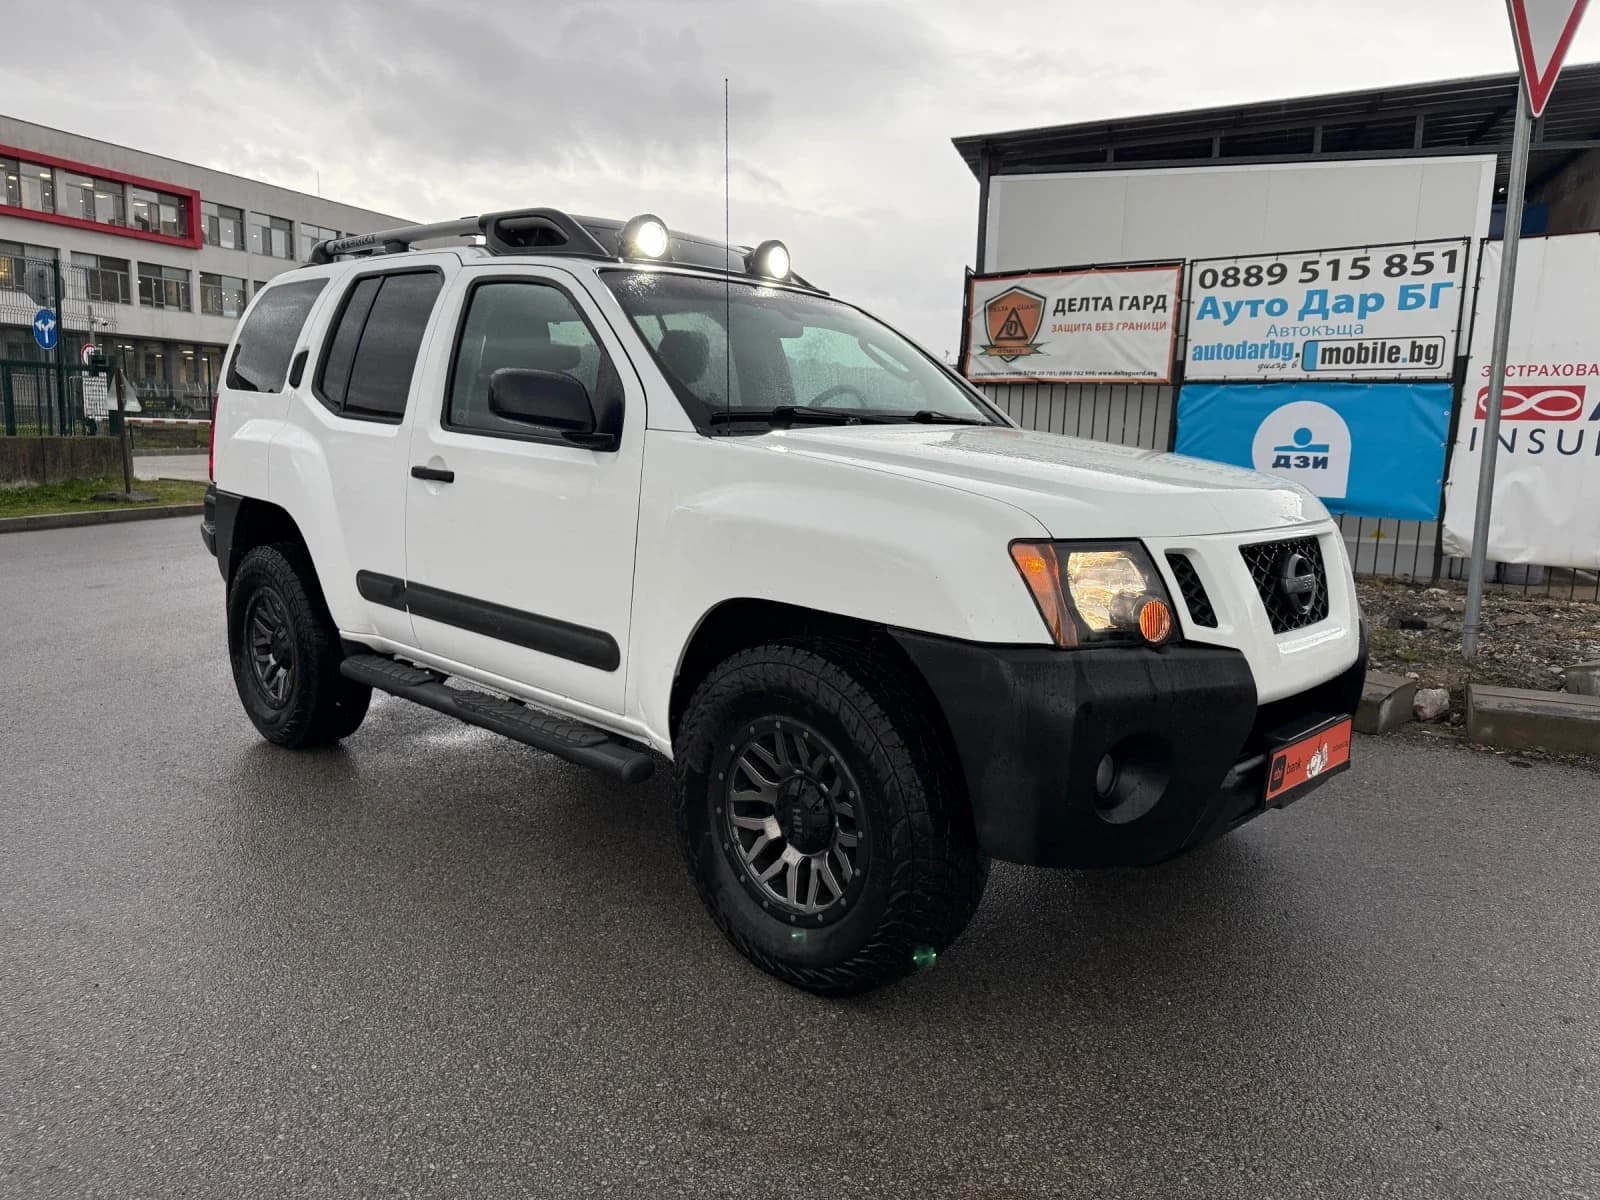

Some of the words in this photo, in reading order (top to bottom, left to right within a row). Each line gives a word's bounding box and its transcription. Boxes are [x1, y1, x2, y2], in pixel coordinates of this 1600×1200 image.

[1198, 262, 1288, 290] 0889
[1297, 256, 1371, 284] 515
[1383, 249, 1458, 278] 851
[1052, 296, 1114, 317] ДЕЛТА
[1118, 294, 1168, 314] ГАРД
[1195, 295, 1289, 327] Ауто
[1297, 288, 1386, 322] Дар
[1397, 281, 1455, 312] БГ
[1050, 323, 1093, 334] ЗАЩИТА
[1095, 321, 1115, 332] БЕЗ
[1115, 320, 1168, 332] ГРАНИЦИ
[1265, 323, 1365, 338] Автокъща
[1319, 340, 1439, 366] mobile.bg
[1480, 363, 1600, 378] ЗСТРАХОВА
[1468, 426, 1600, 457] INSU
